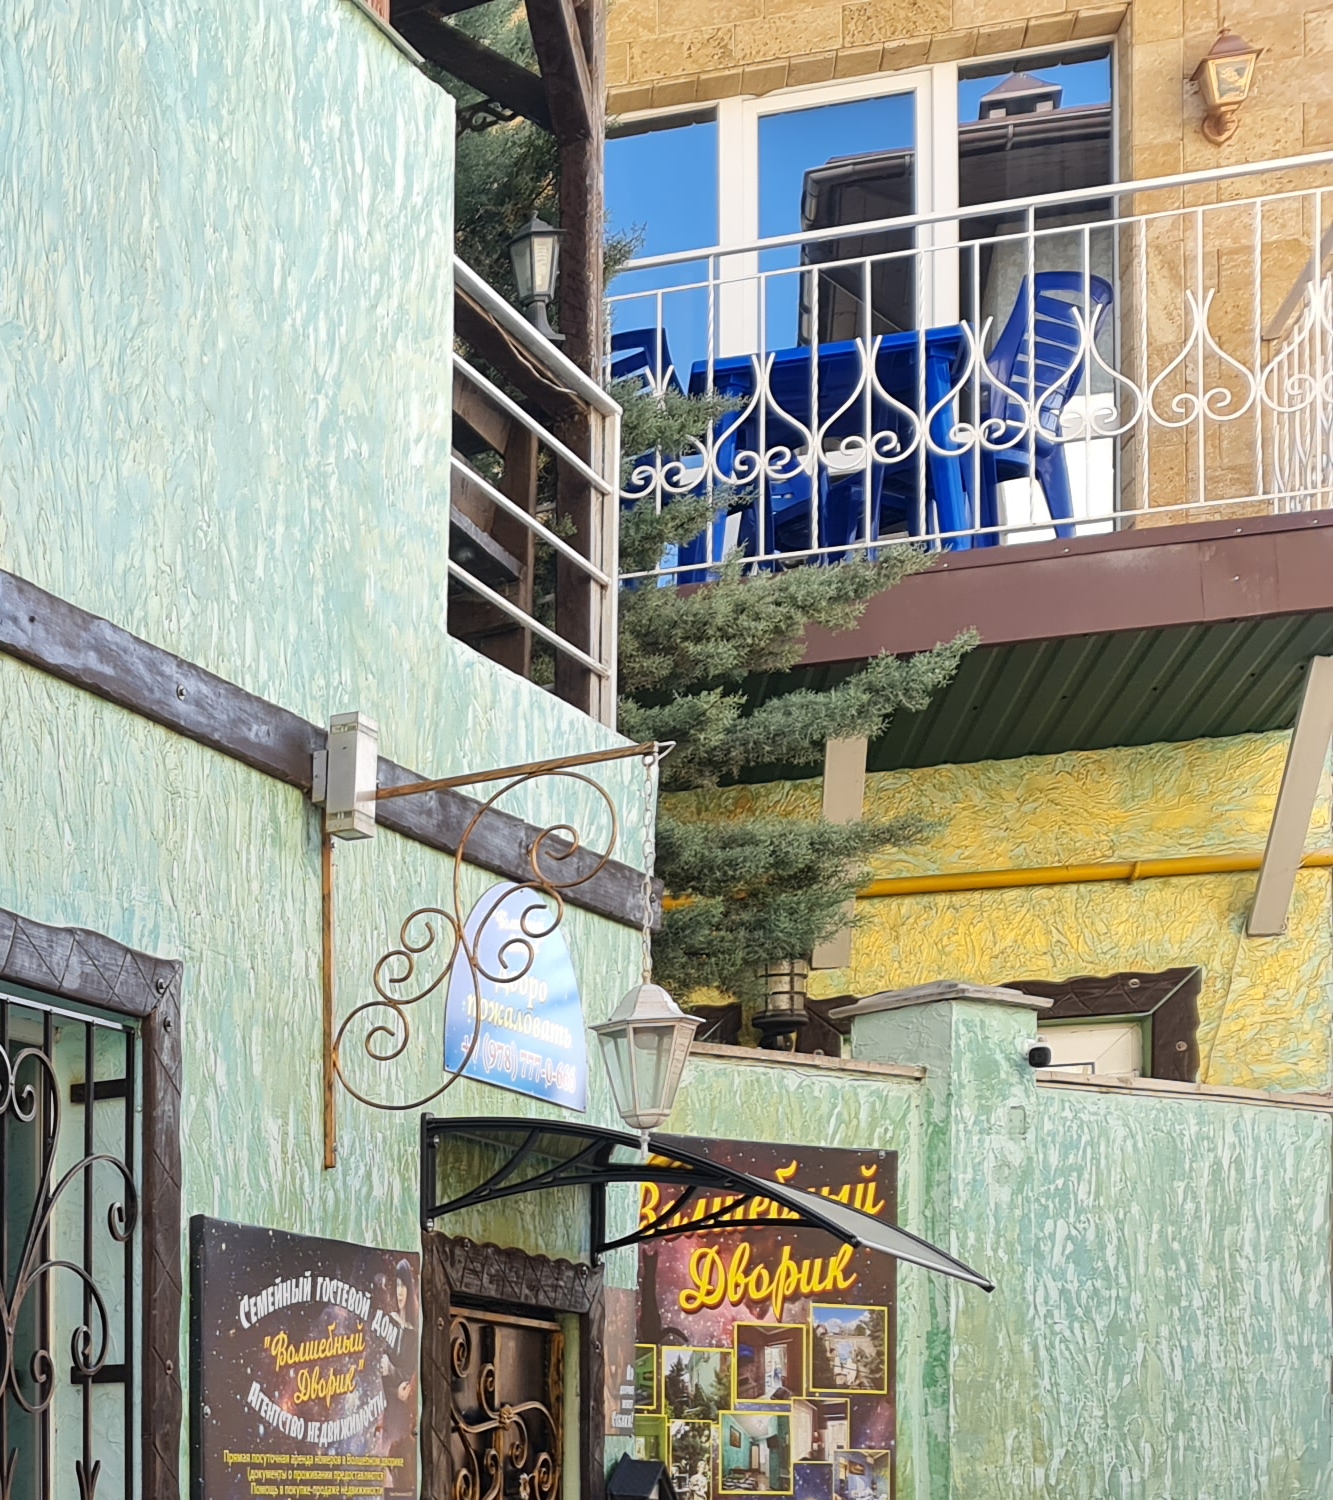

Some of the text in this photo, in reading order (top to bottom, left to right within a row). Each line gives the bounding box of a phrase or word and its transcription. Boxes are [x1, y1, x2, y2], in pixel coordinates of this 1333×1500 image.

[482, 1035, 517, 1082] (978)
[679, 1242, 857, 1319] Дворик
[264, 1322, 366, 1371] "Волшебный
